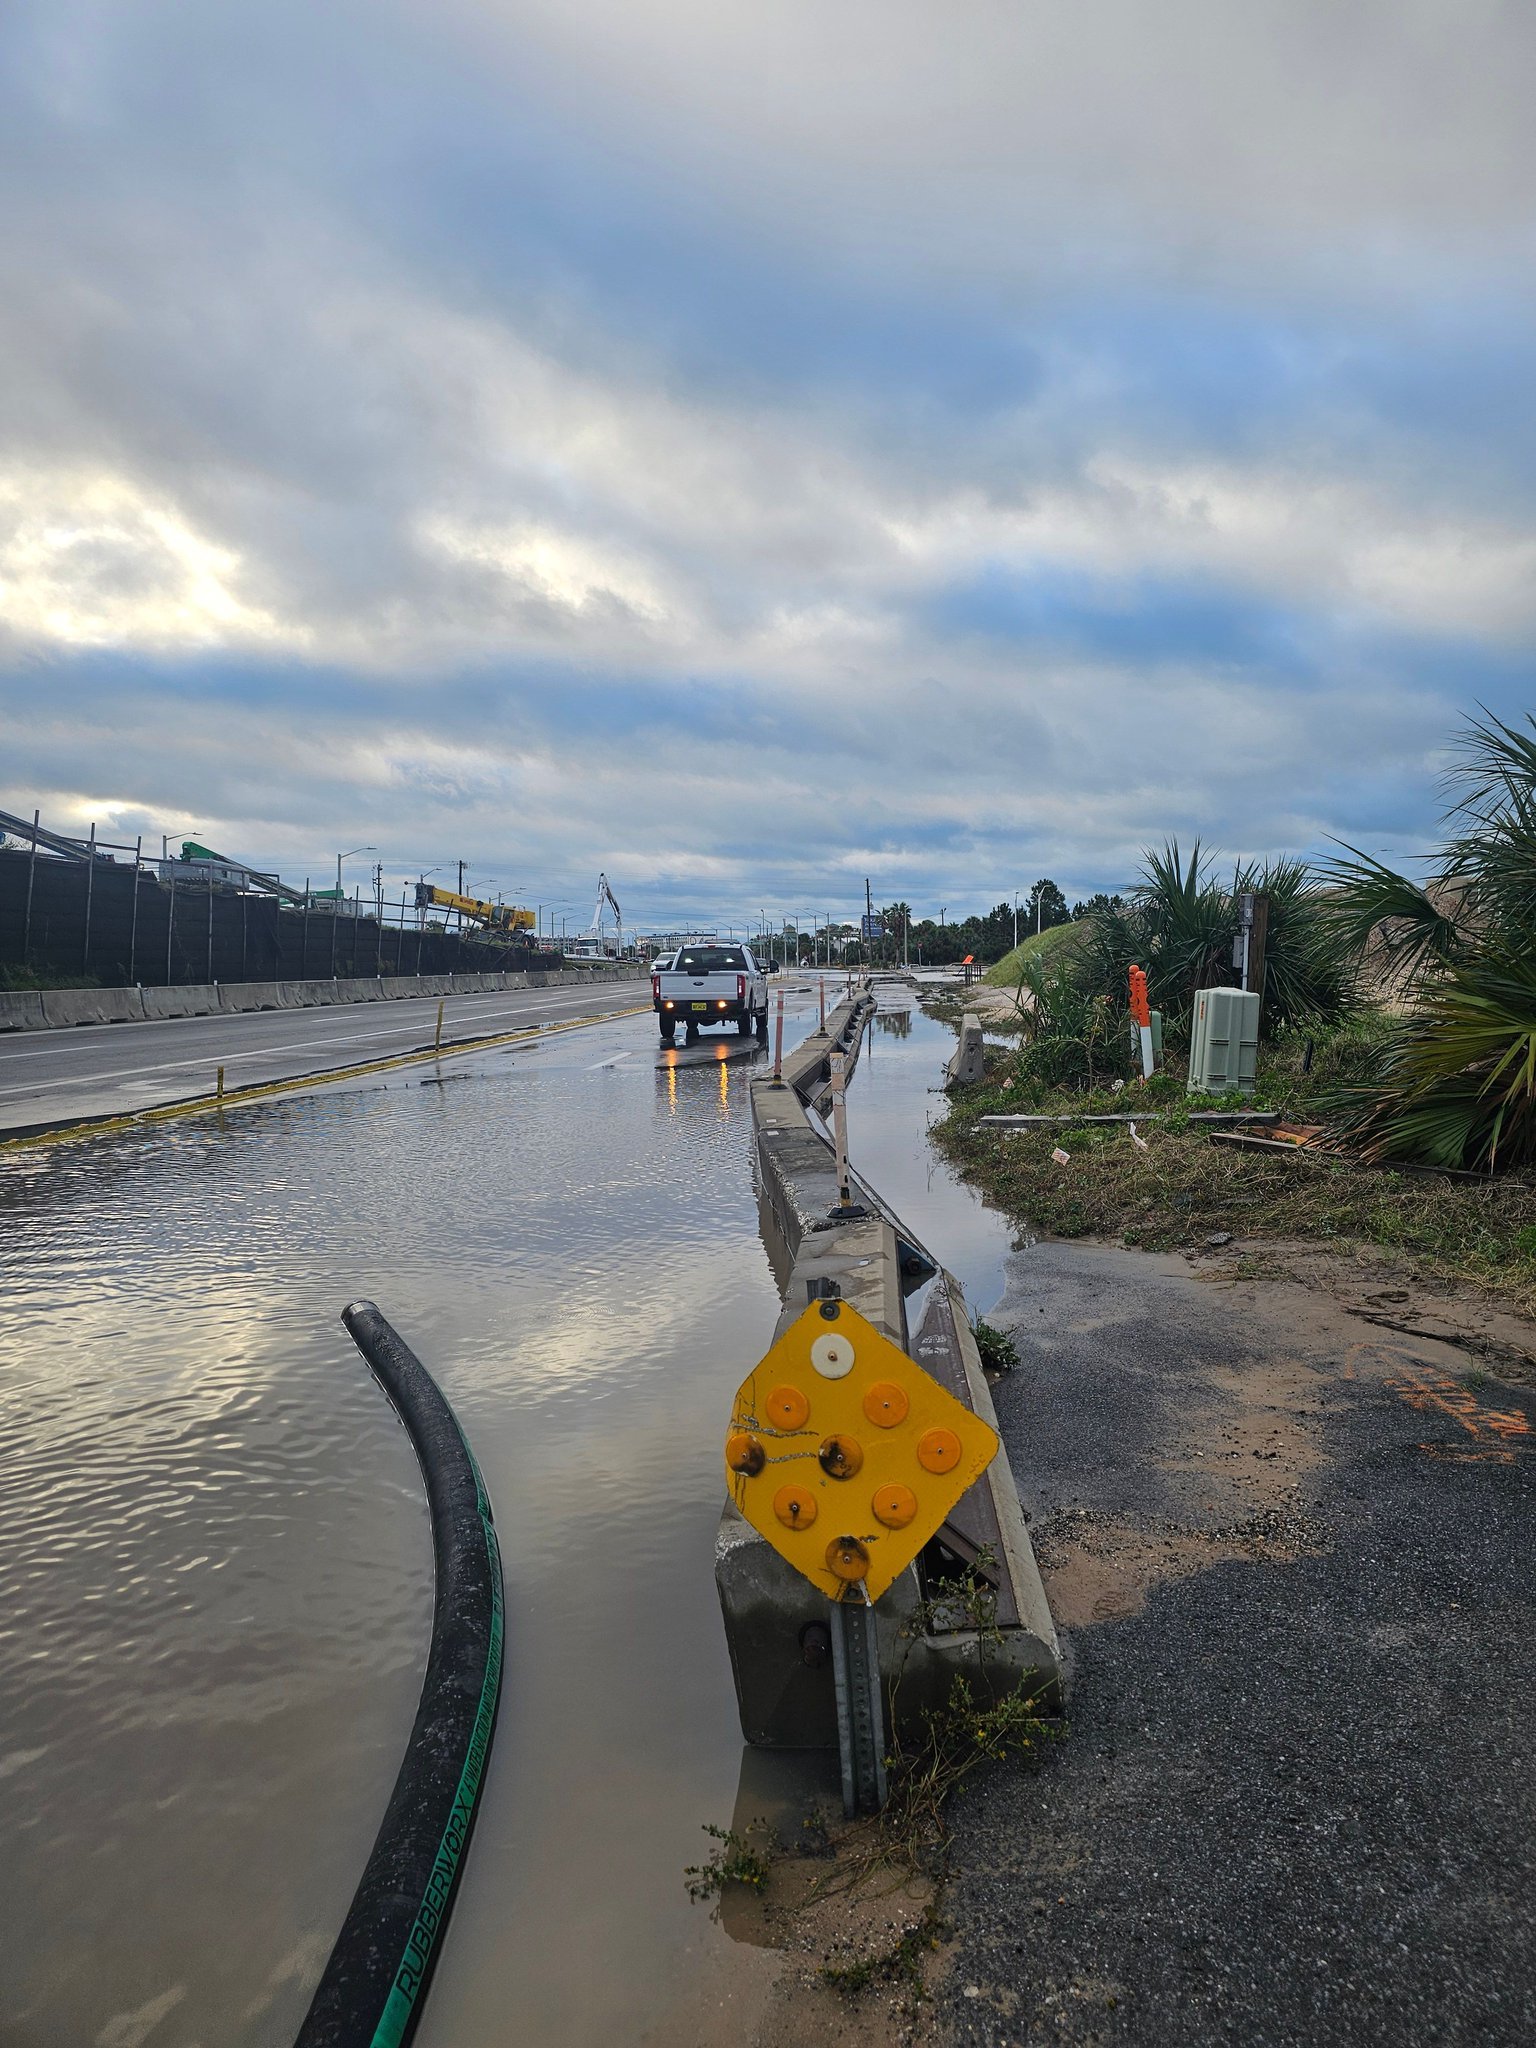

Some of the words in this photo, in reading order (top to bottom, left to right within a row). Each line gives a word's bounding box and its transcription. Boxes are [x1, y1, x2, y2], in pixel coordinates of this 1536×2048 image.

[473, 1712, 490, 1757] SUCTION
[465, 1746, 483, 1785] WATER
[395, 1793, 472, 2004] RUBBERWORX
